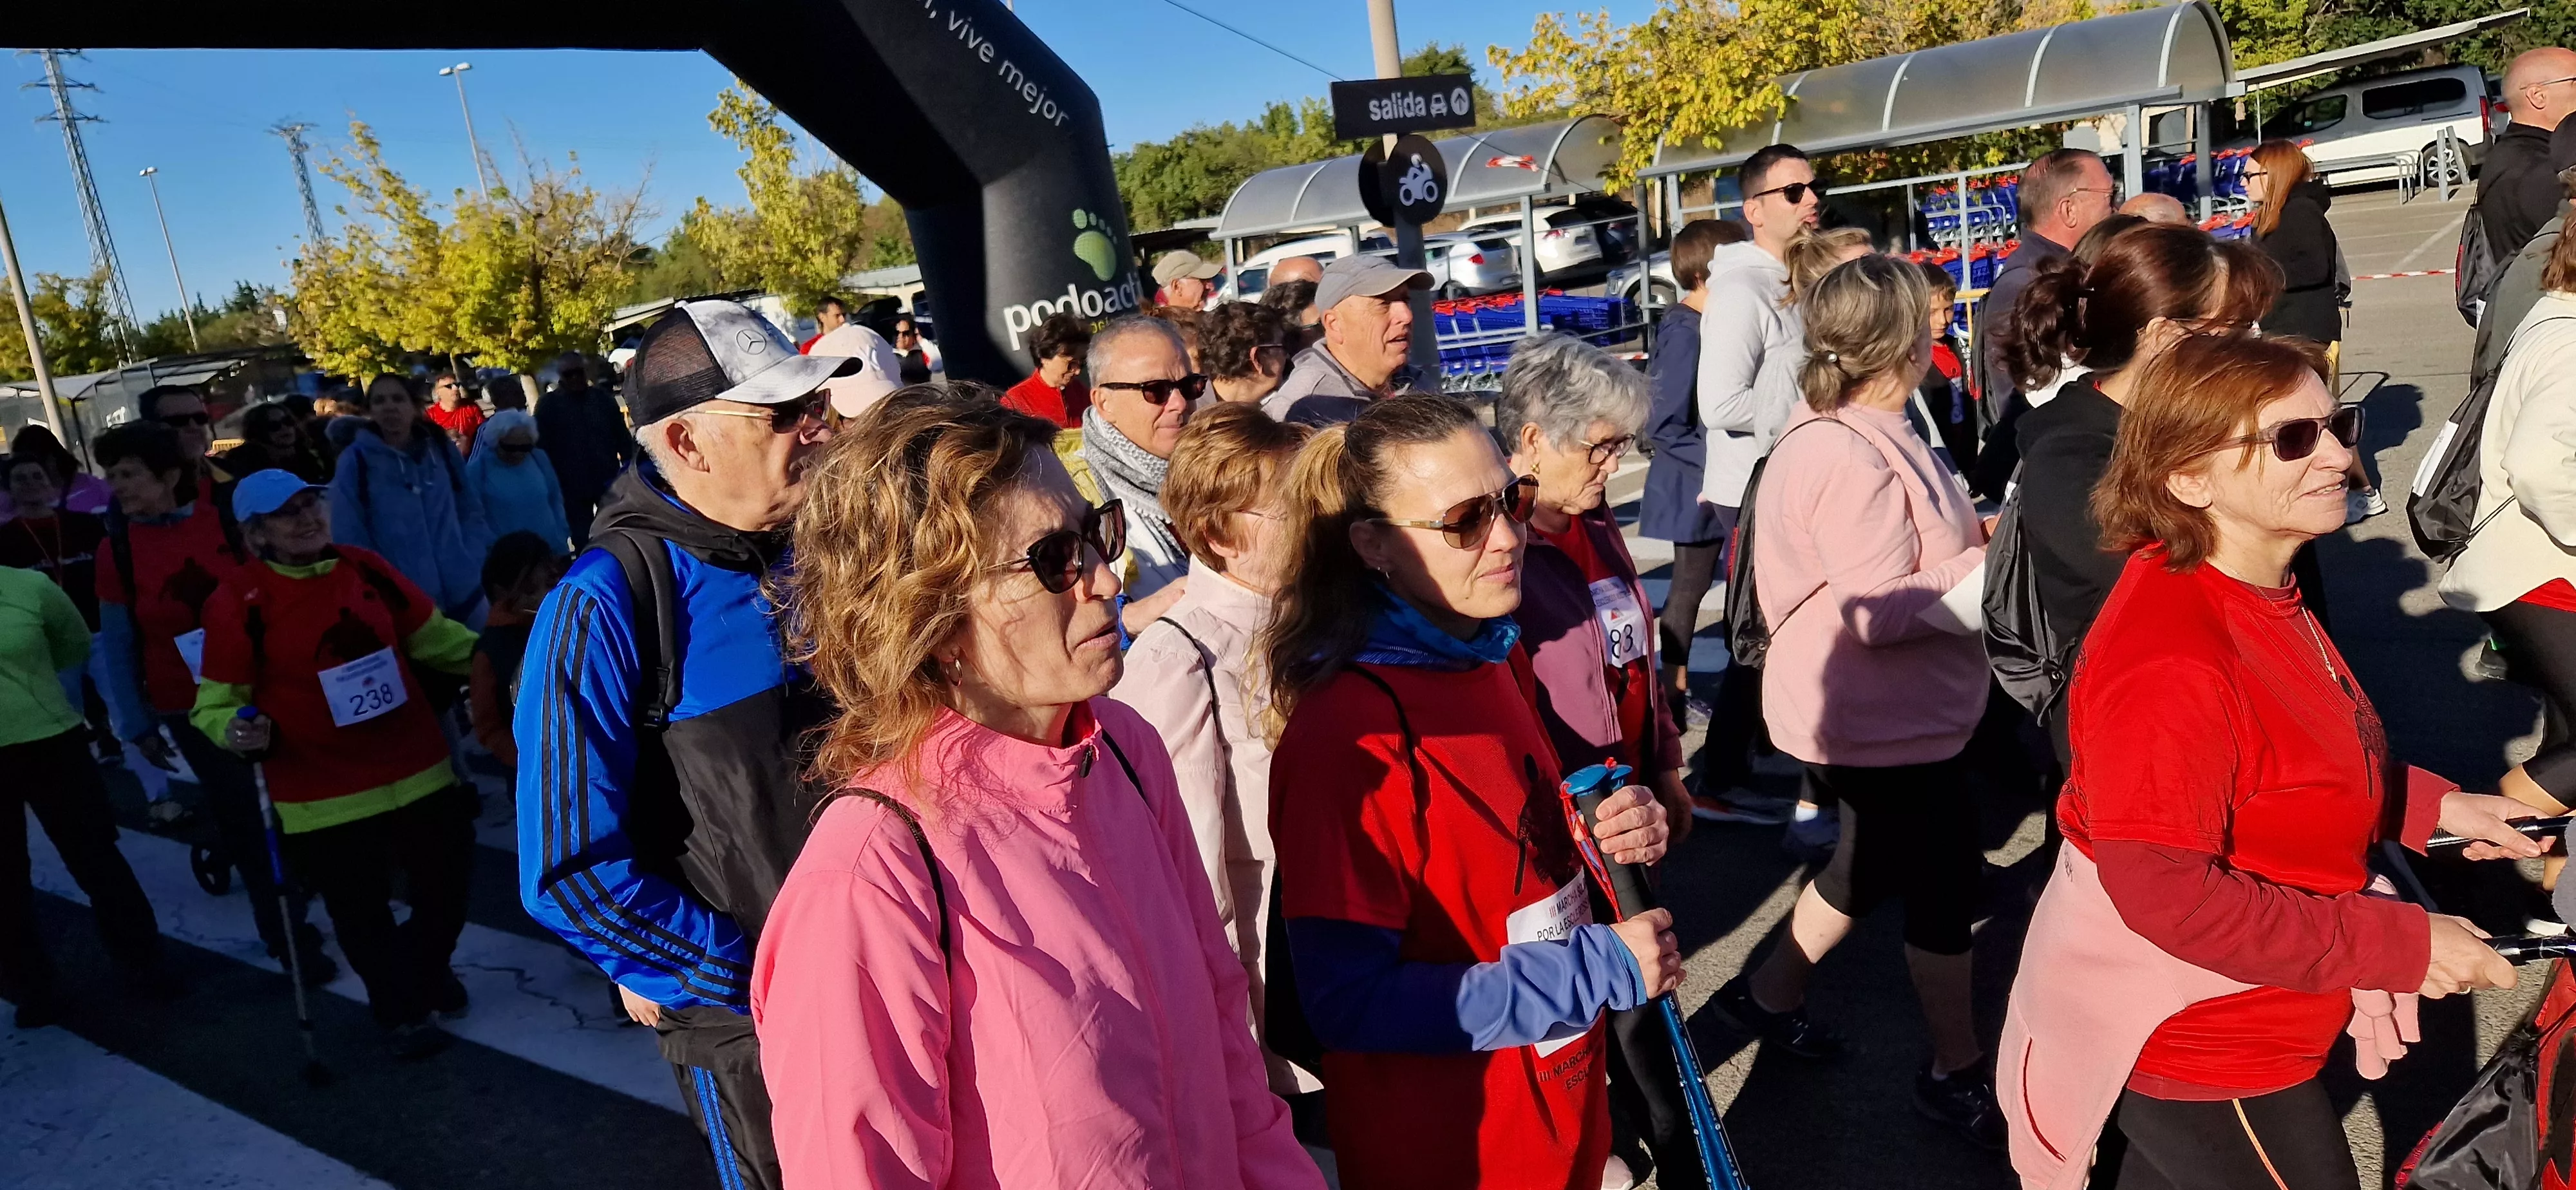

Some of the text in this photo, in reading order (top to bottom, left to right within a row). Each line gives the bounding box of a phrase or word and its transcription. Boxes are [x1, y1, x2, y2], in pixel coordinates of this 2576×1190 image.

[949, 10, 1069, 126] vive mejor
[1368, 91, 1426, 121] salida
[1610, 624, 1633, 659] 83
[350, 683, 393, 716] 238
[1557, 889, 1577, 914] MARCHA
[1537, 927, 1555, 941] POR
[1555, 921, 1565, 936] LA
